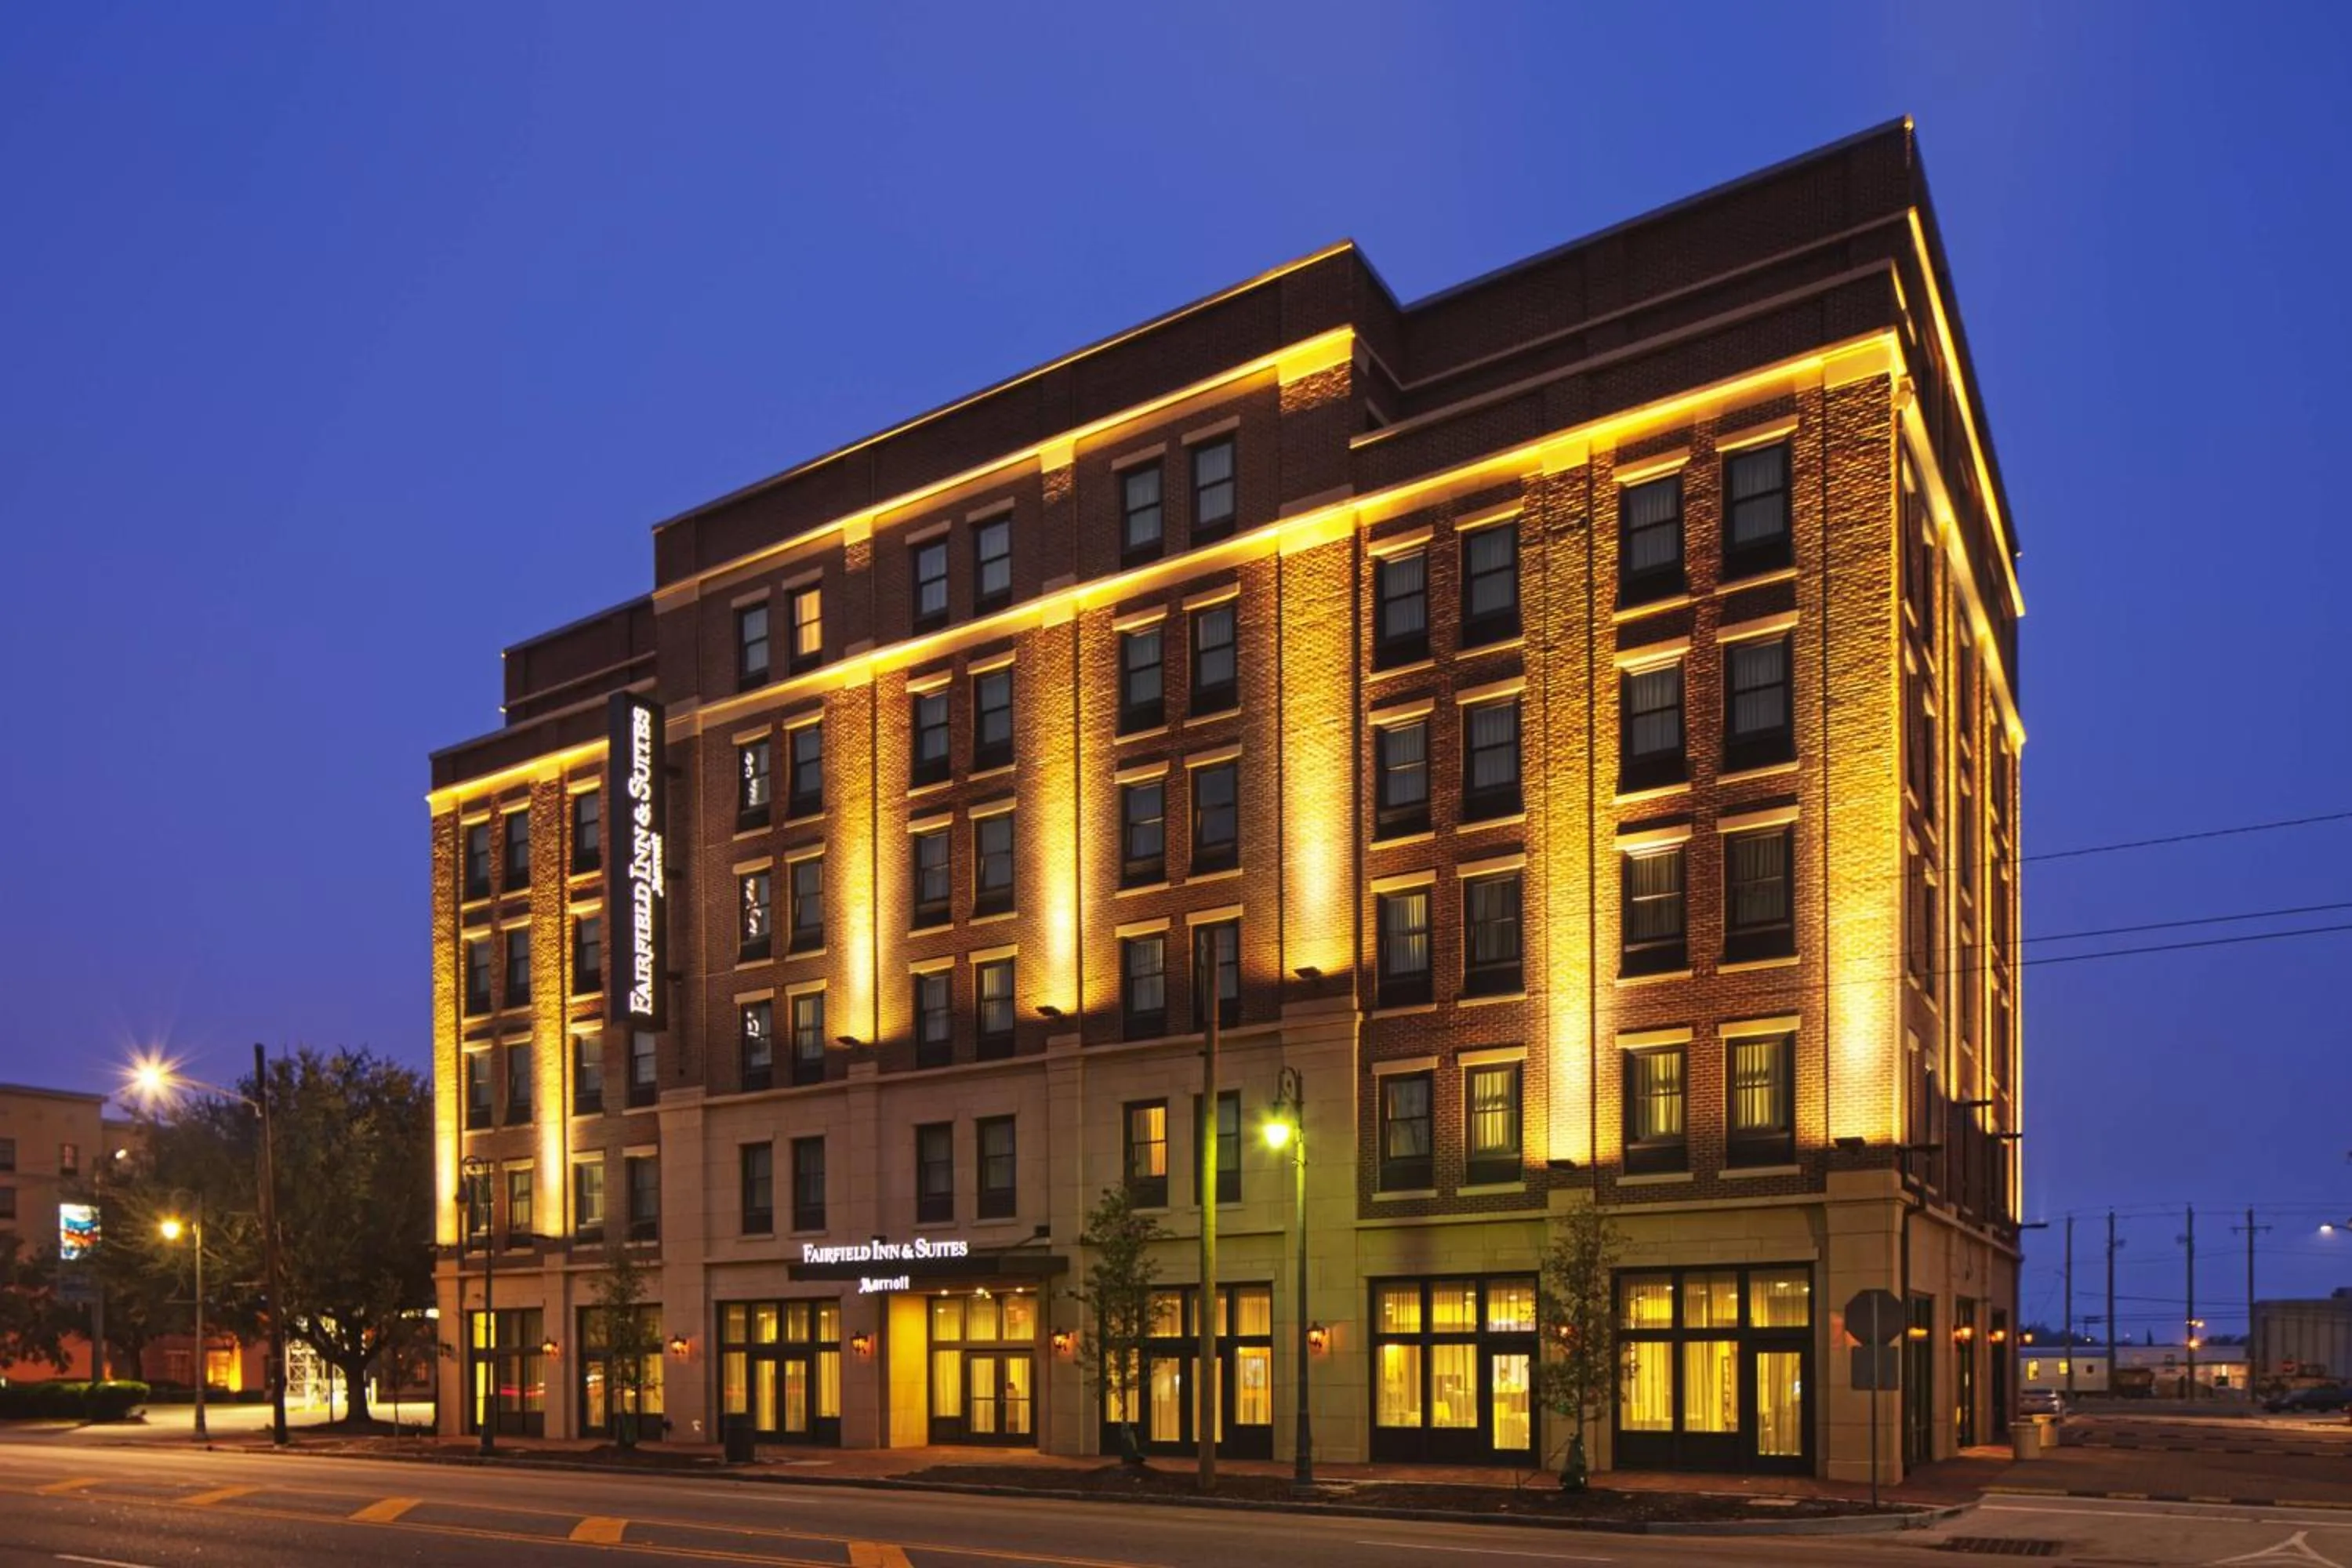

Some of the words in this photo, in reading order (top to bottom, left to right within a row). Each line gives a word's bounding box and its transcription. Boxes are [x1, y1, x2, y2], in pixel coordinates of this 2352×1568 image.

[629, 706, 652, 800] SUITES
[634, 803, 652, 826] &
[630, 825, 652, 882] INN
[630, 881, 654, 1016] FAIRFIELD
[803, 1243, 871, 1264] FAIRFIELD
[872, 1240, 901, 1260] INN
[901, 1244, 915, 1259] &
[915, 1238, 968, 1258] SUITES
